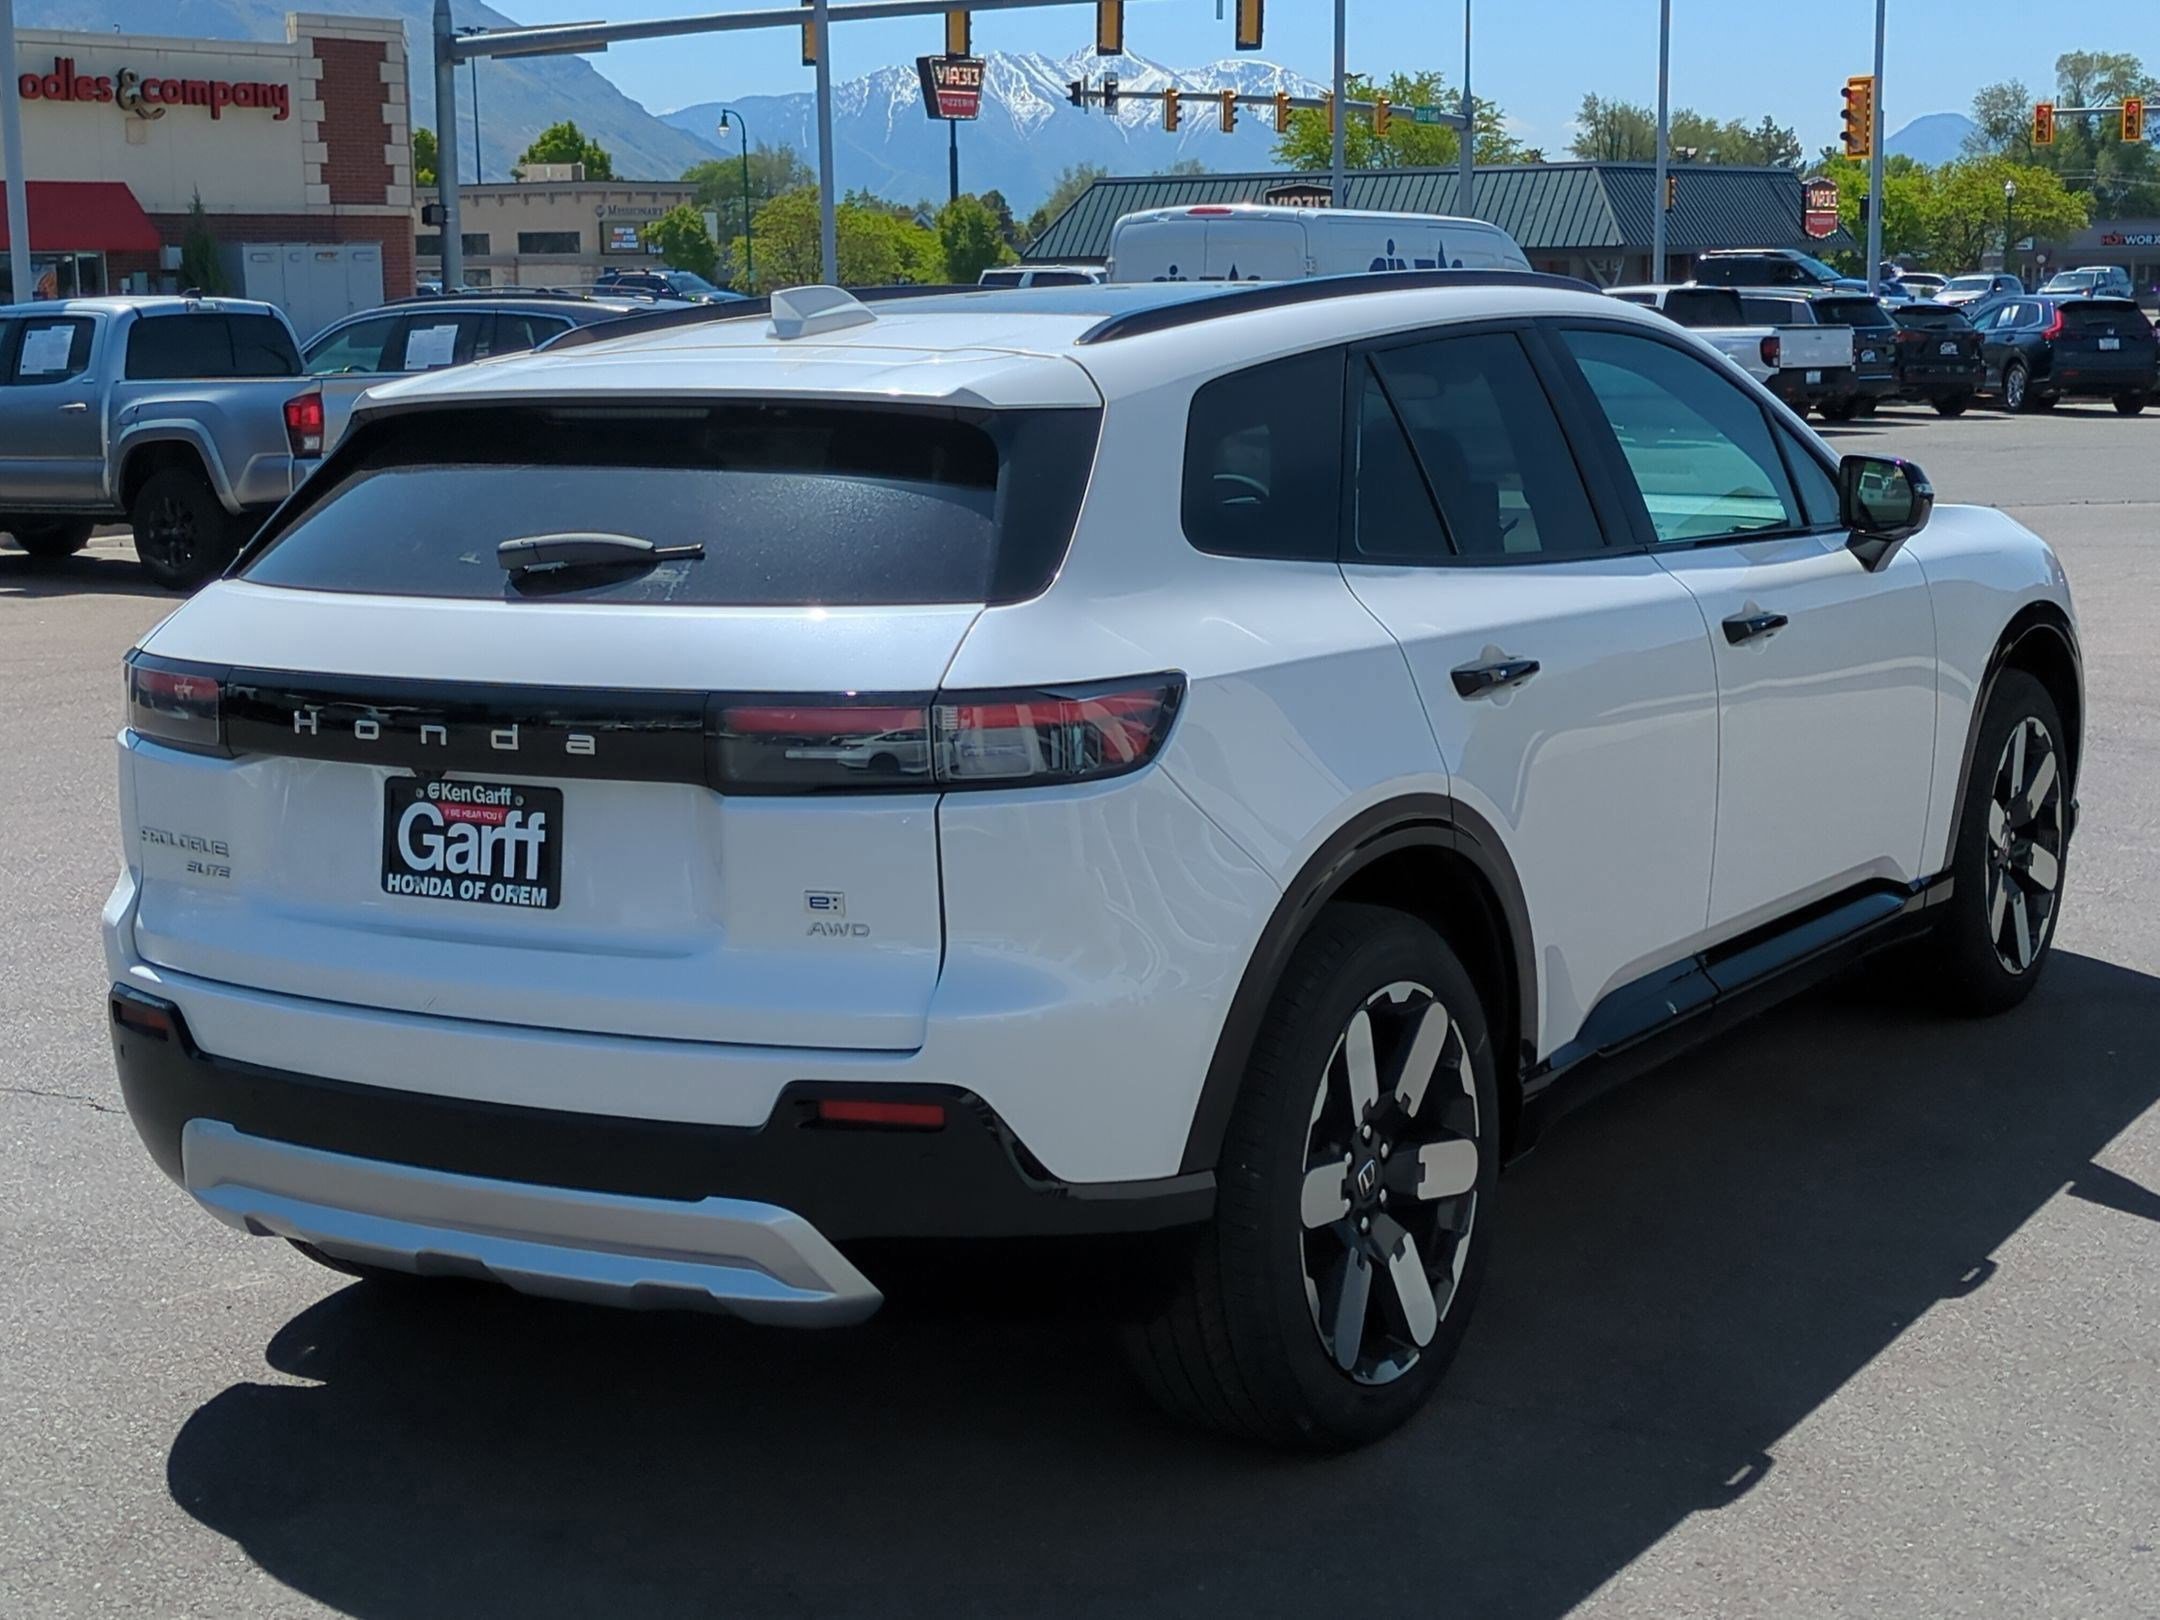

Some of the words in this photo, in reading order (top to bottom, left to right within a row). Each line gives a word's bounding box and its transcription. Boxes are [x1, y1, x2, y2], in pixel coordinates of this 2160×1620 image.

[116, 67, 166, 119] &
[142, 78, 289, 120] company
[293, 709, 596, 756] Honda
[441, 783, 472, 802] Ken
[472, 785, 512, 805] Garff
[397, 801, 546, 881] Garff
[387, 873, 454, 898] HONDA
[459, 879, 486, 900] OF
[490, 883, 548, 907] OREM
[806, 921, 871, 937] AWD
